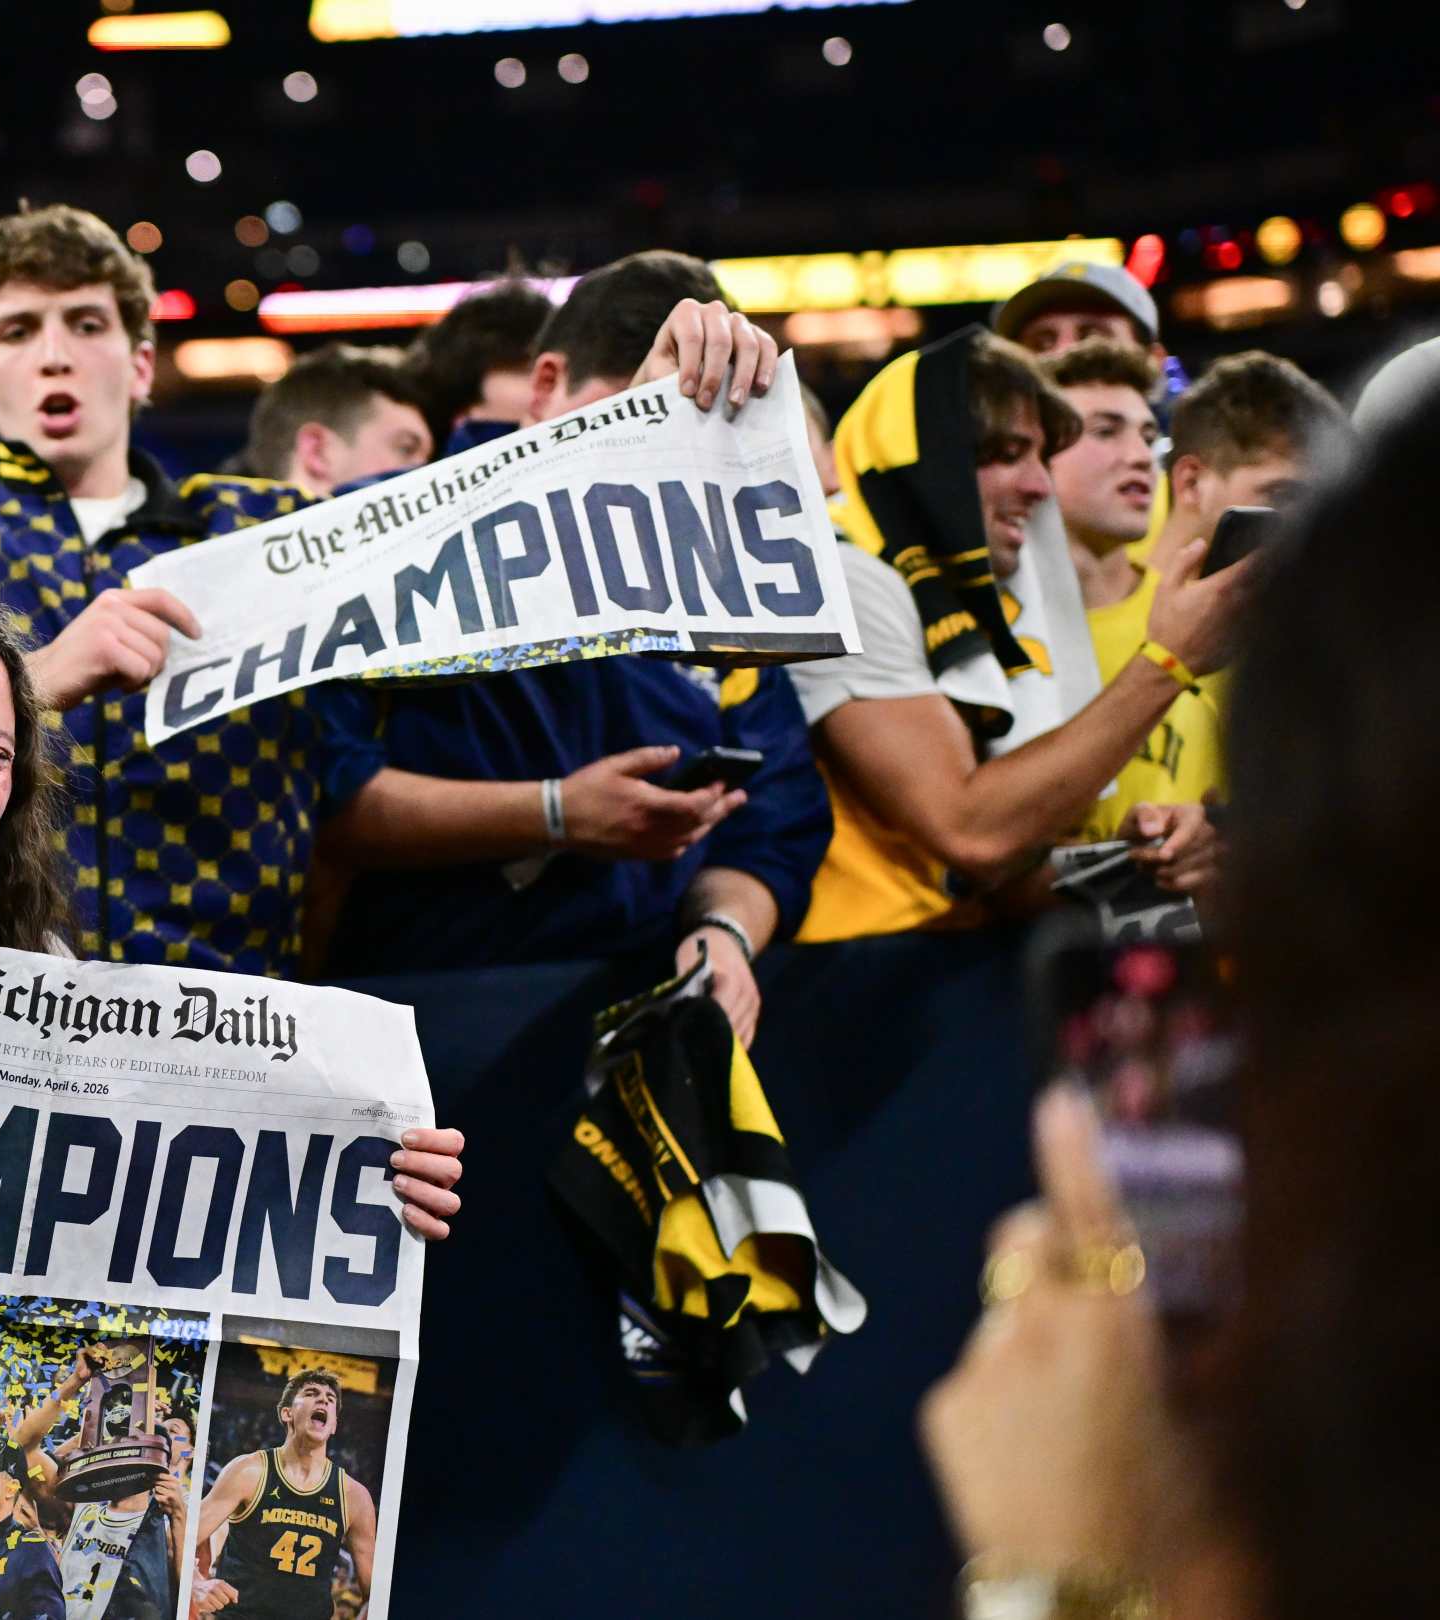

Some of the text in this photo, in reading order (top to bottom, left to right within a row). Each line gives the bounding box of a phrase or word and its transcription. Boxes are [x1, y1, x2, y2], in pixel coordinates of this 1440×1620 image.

[263, 526, 345, 574] The
[354, 440, 540, 544] Michigan
[550, 390, 670, 446] Daily
[164, 479, 825, 728] CHAMPIONS
[171, 982, 299, 1062] Daily
[32, 1049, 62, 1065] FIVE
[65, 1054, 108, 1068] YEARS
[110, 1057, 127, 1070] OF
[130, 1060, 201, 1077] EDITORIAL
[205, 1067, 267, 1083] FREEDOM
[44, 1078, 69, 1093] April
[71, 1082, 80, 1095] 6,
[83, 1083, 110, 1095] 2026
[261, 1507, 338, 1538] MICHIGAN
[270, 1530, 323, 1577] 42
[82, 1562, 102, 1601] 1
